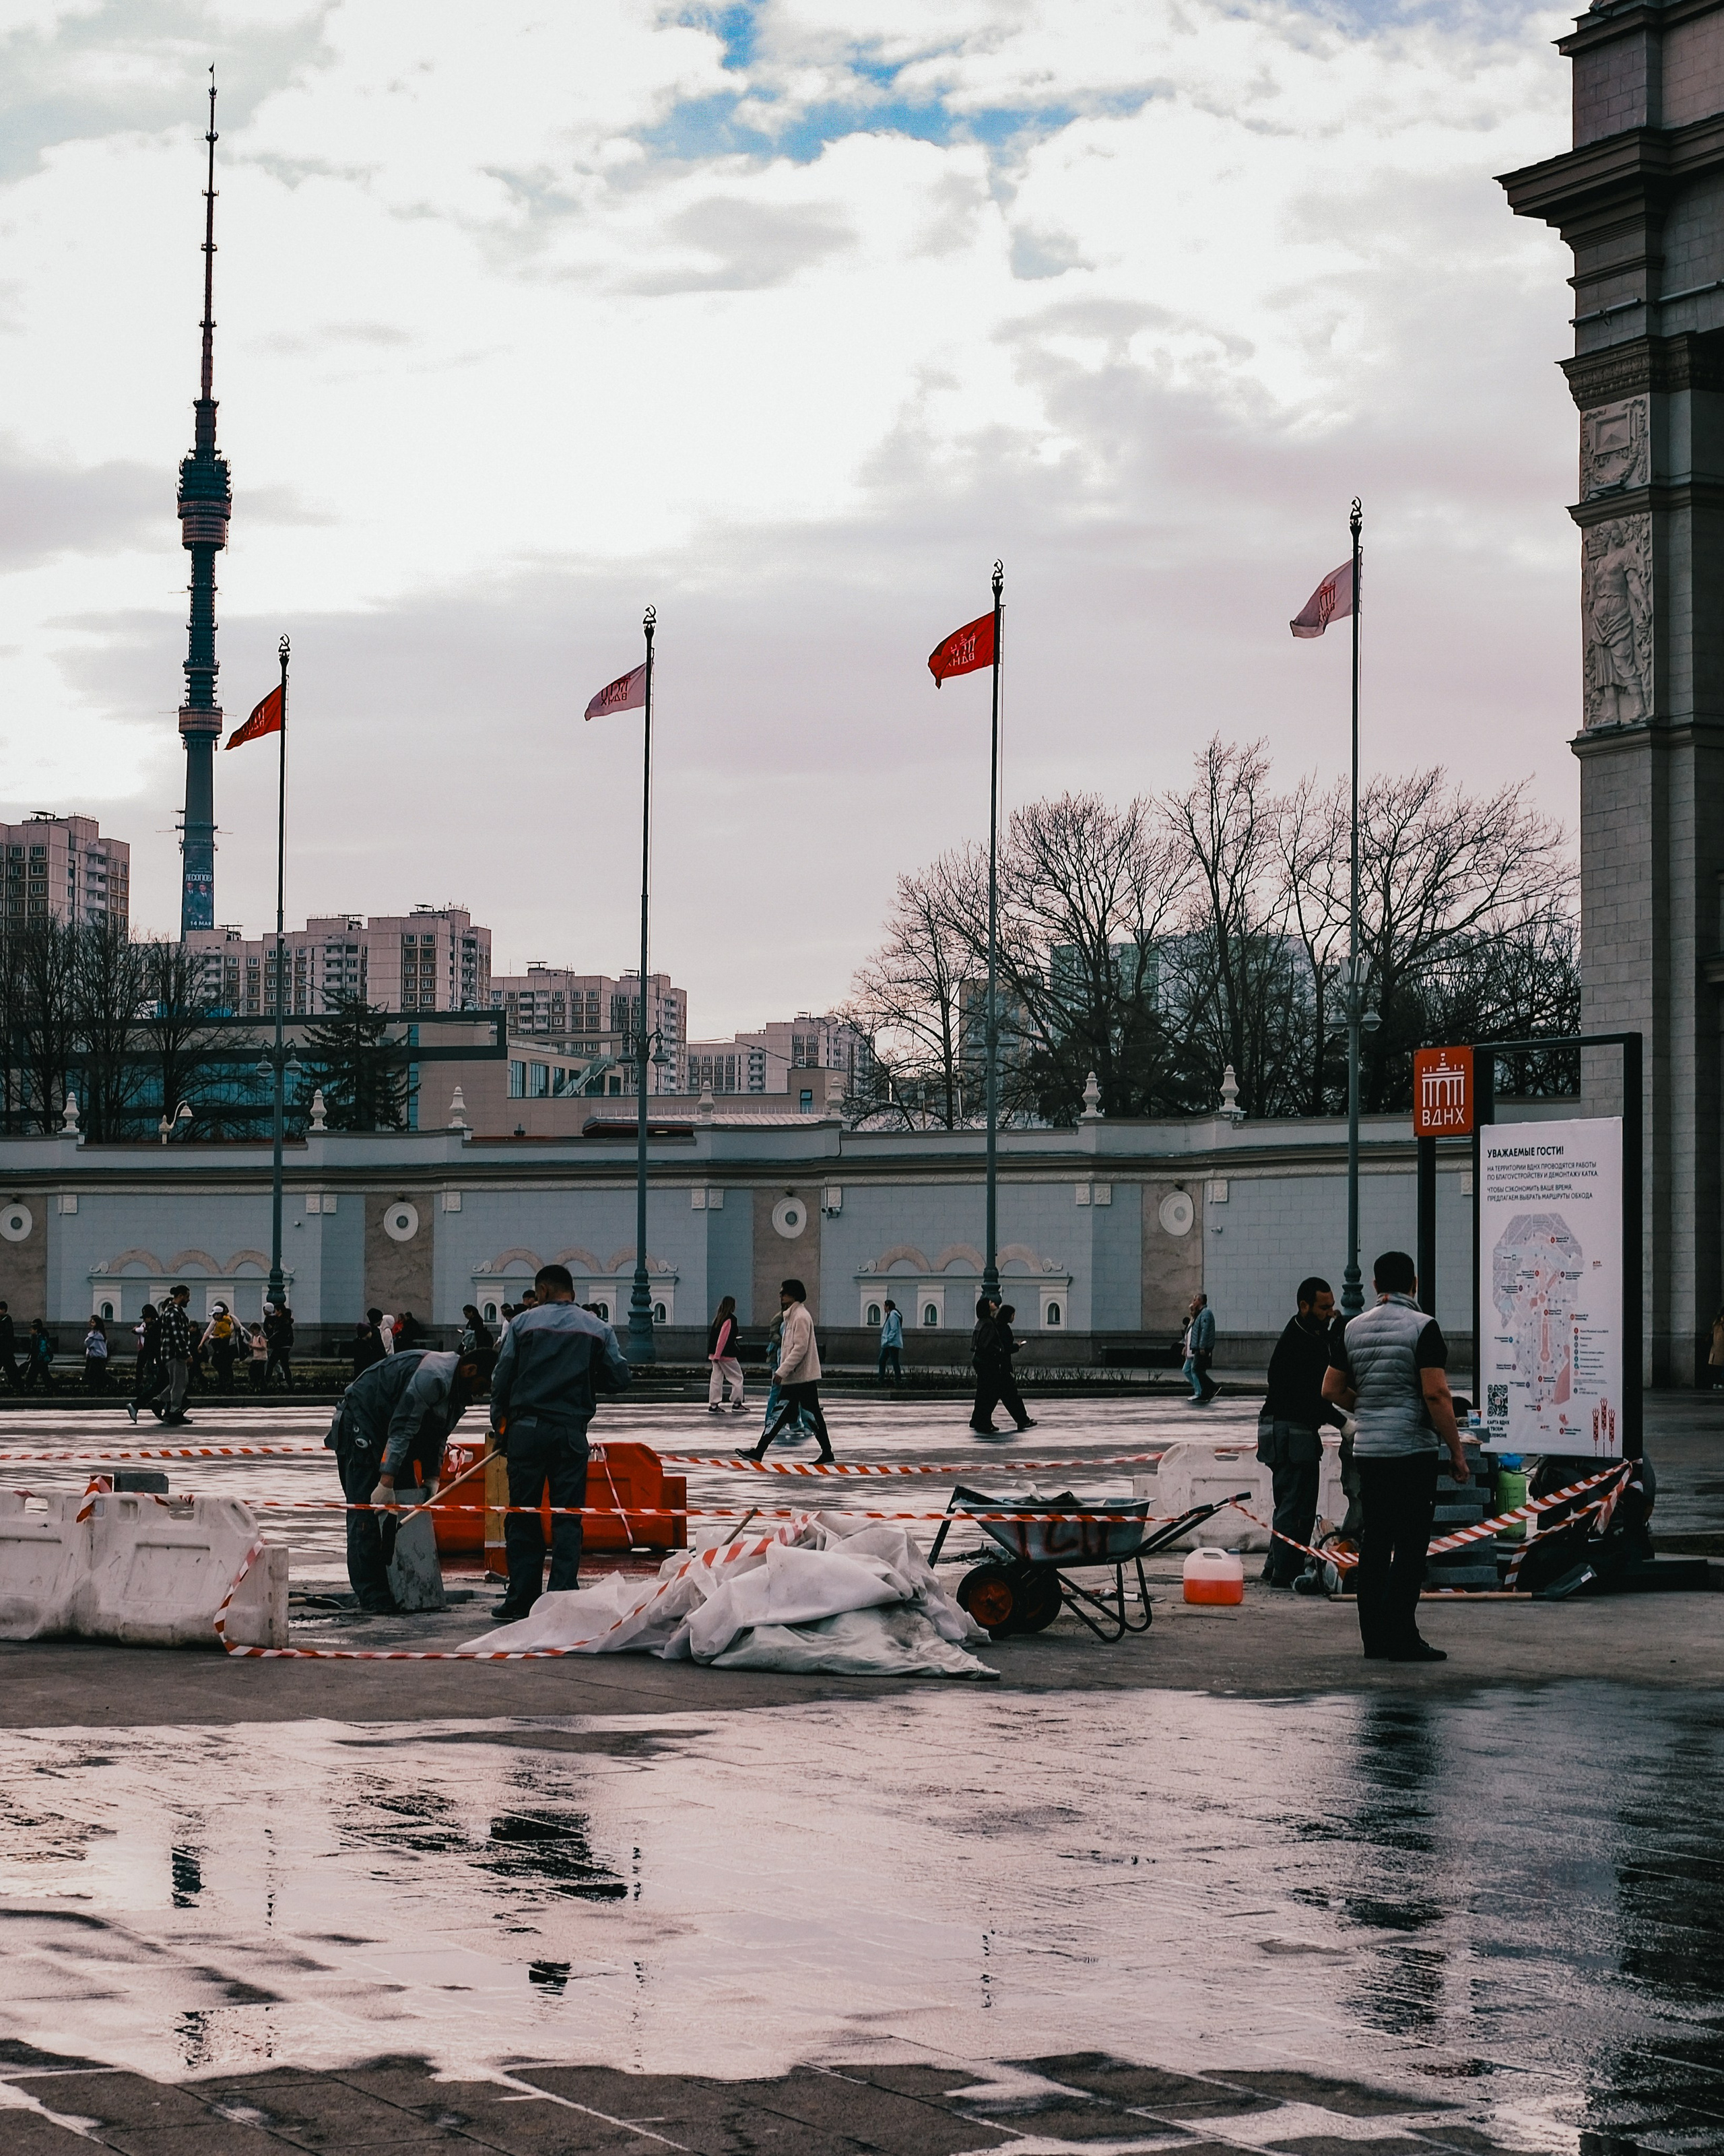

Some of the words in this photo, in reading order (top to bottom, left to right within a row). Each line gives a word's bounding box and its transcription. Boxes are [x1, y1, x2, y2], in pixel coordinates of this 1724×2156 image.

[1422, 1107, 1465, 1127] ВДНХ
[1487, 1147, 1535, 1158] УВАЖАЕМЫЕ
[1536, 1146, 1564, 1156] ГОСТИ!
[1541, 1162, 1575, 1170] ПРОВОДЯТСЯ
[1496, 1171, 1543, 1180] БЛАГОУСТРОЙСТВУ
[1548, 1171, 1581, 1179] ДЕМОНТАЖУ
[1504, 1185, 1539, 1193] СЭКОНОМИТЬ
[1487, 1194, 1519, 1202] ПРЕДЛАГАЕМ
[1541, 1192, 1570, 1200] МАРШРУТЫ
